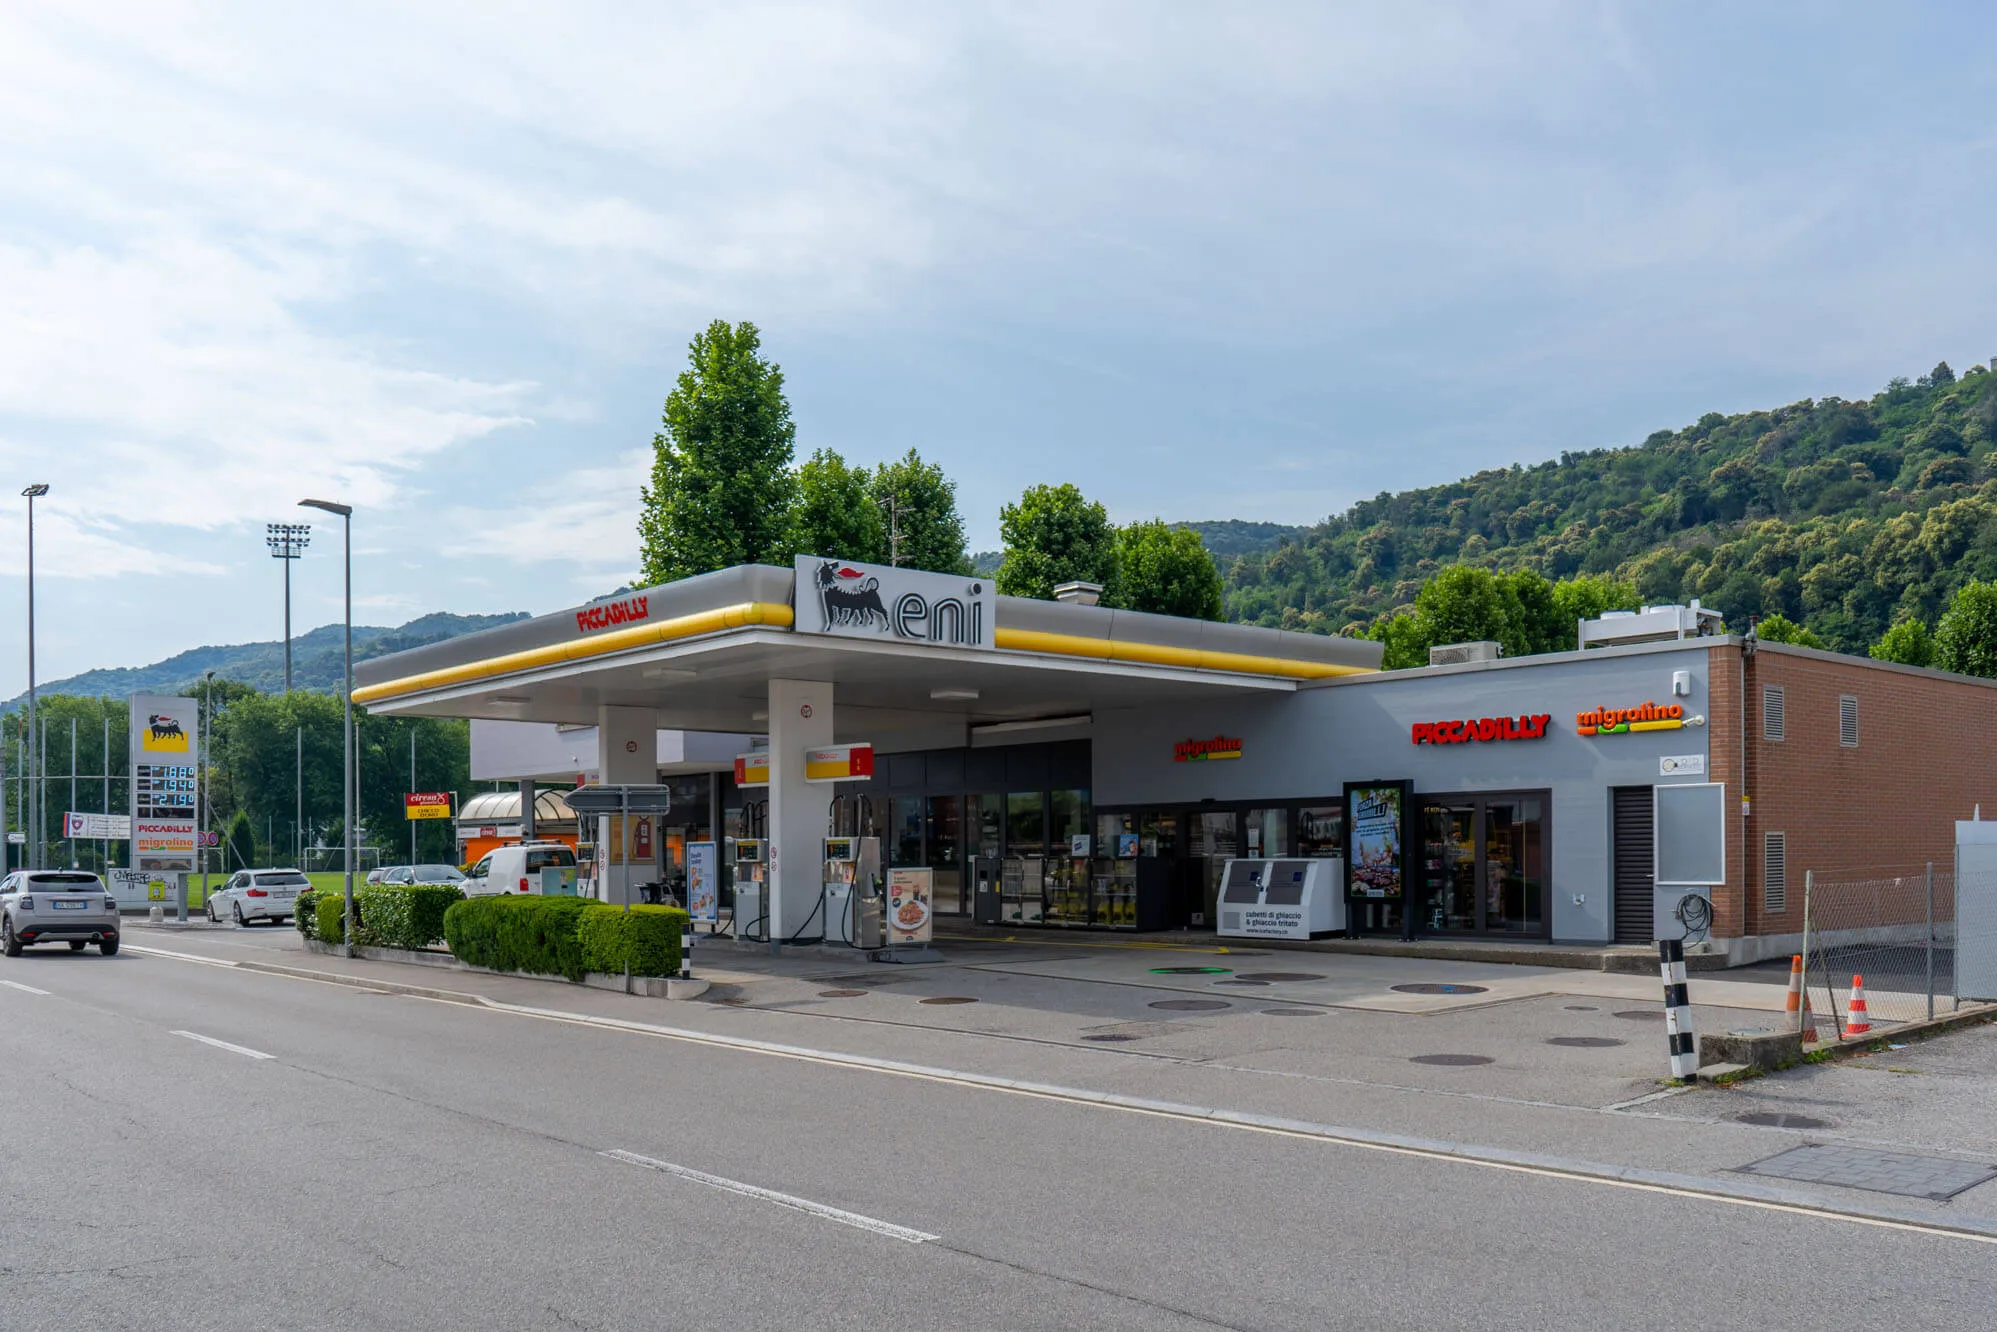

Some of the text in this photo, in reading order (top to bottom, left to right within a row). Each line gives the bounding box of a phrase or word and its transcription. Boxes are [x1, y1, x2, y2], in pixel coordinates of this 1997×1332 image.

[895, 583, 982, 645] eni
[1577, 701, 1683, 729] migrolino
[1174, 735, 1242, 757] migrolino
[138, 837, 193, 848] migrolino
[1276, 912, 1302, 920] ghiaccio
